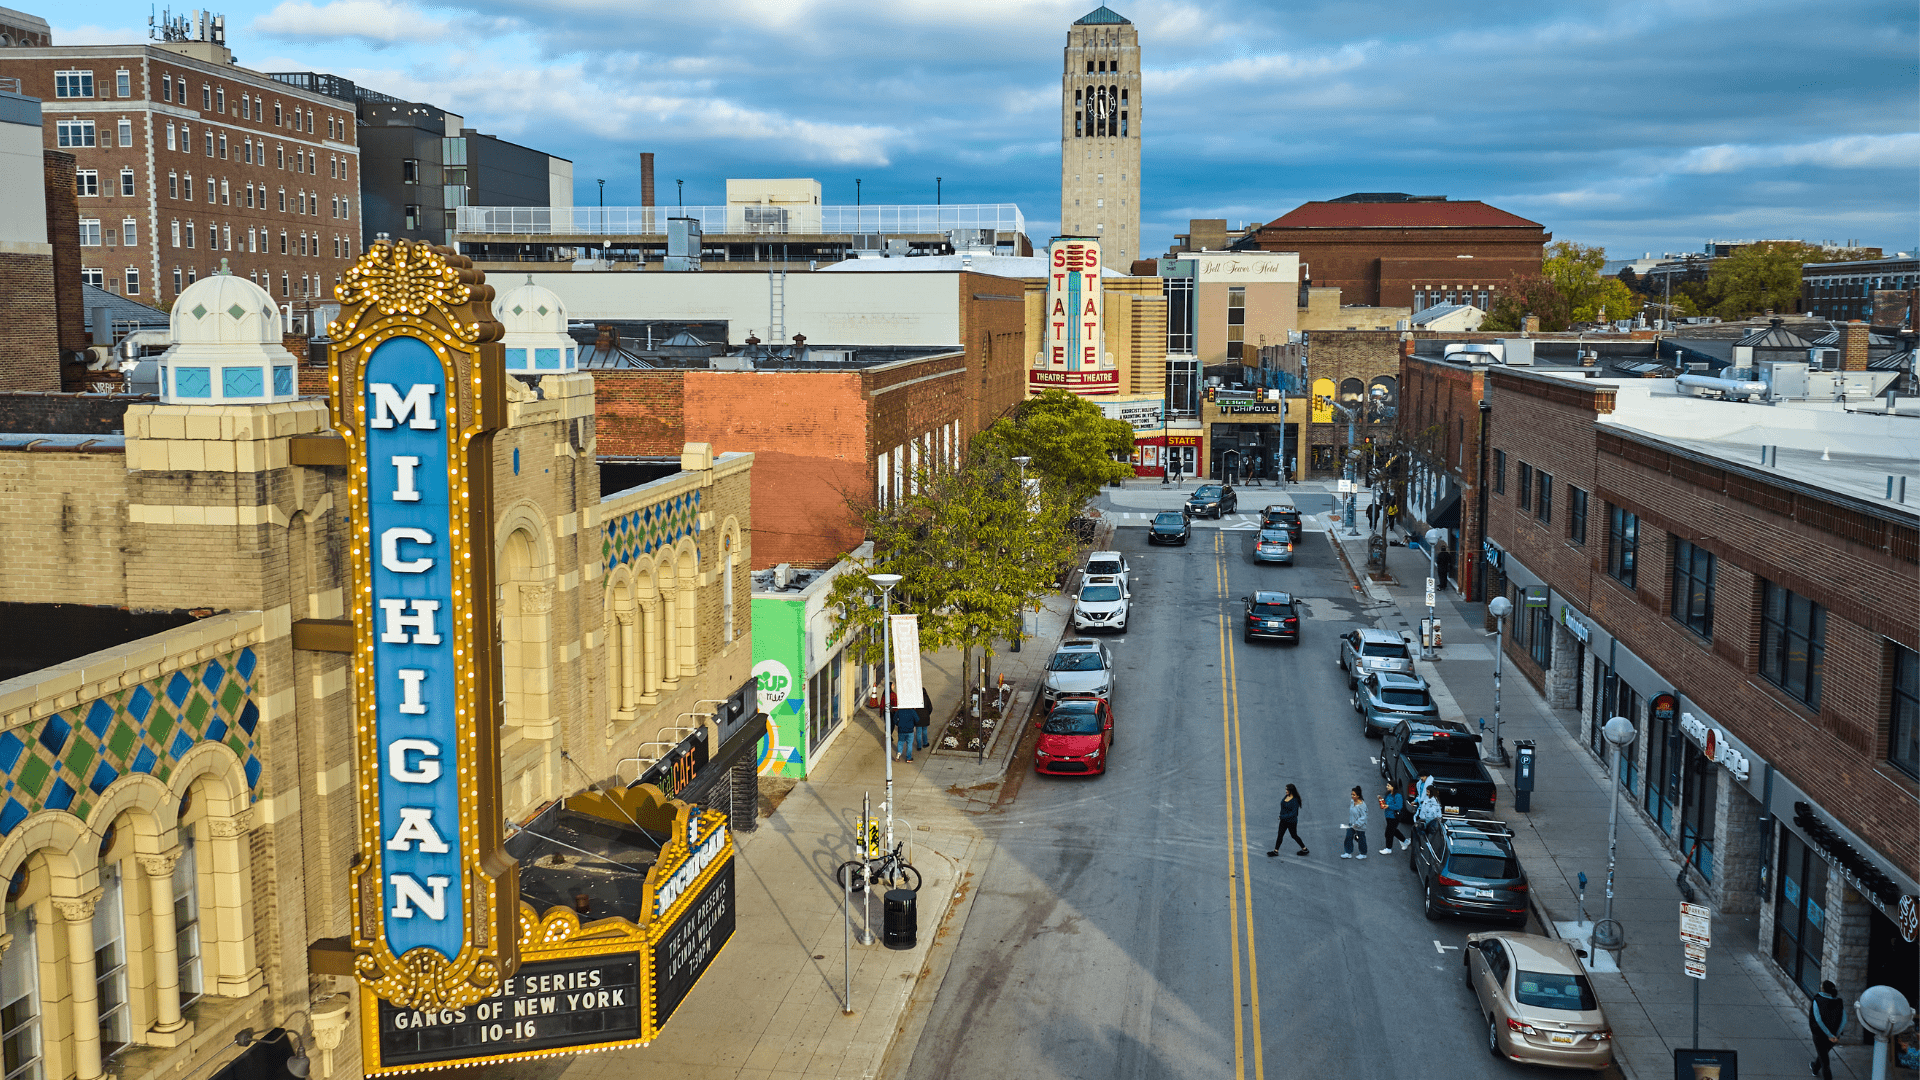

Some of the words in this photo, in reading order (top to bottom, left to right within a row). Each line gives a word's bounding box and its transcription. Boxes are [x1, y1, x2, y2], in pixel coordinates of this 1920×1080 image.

[1200, 260, 1221, 274] Bell
[1223, 260, 1250, 274] Tower
[1252, 260, 1279, 274] Hotel
[1053, 249, 1065, 365] STATE
[1084, 249, 1097, 365] STATE
[1036, 373, 1065, 383] THEATRE
[1083, 373, 1112, 382] THEATRE
[1168, 437, 1196, 445] STATE
[368, 382, 451, 921] MICHIGAN
[673, 747, 697, 795] CAFE
[658, 824, 726, 917] MICHIGAN
[668, 934, 682, 955] THE
[682, 921, 696, 943] ARK
[697, 878, 727, 925] PRESENTS
[1681, 904, 1688, 912] NO
[1688, 906, 1709, 915] PARKING
[668, 941, 697, 981] LUCINDA
[697, 899, 726, 947] WILLIAMS
[689, 936, 712, 976] 7:30PM
[525, 970, 601, 994] SERIES
[394, 1006, 467, 1030] GANGS
[476, 1001, 503, 1021] OF
[514, 996, 557, 1018] NEW
[567, 989, 625, 1012] YORK
[480, 1020, 537, 1043] 10-16
